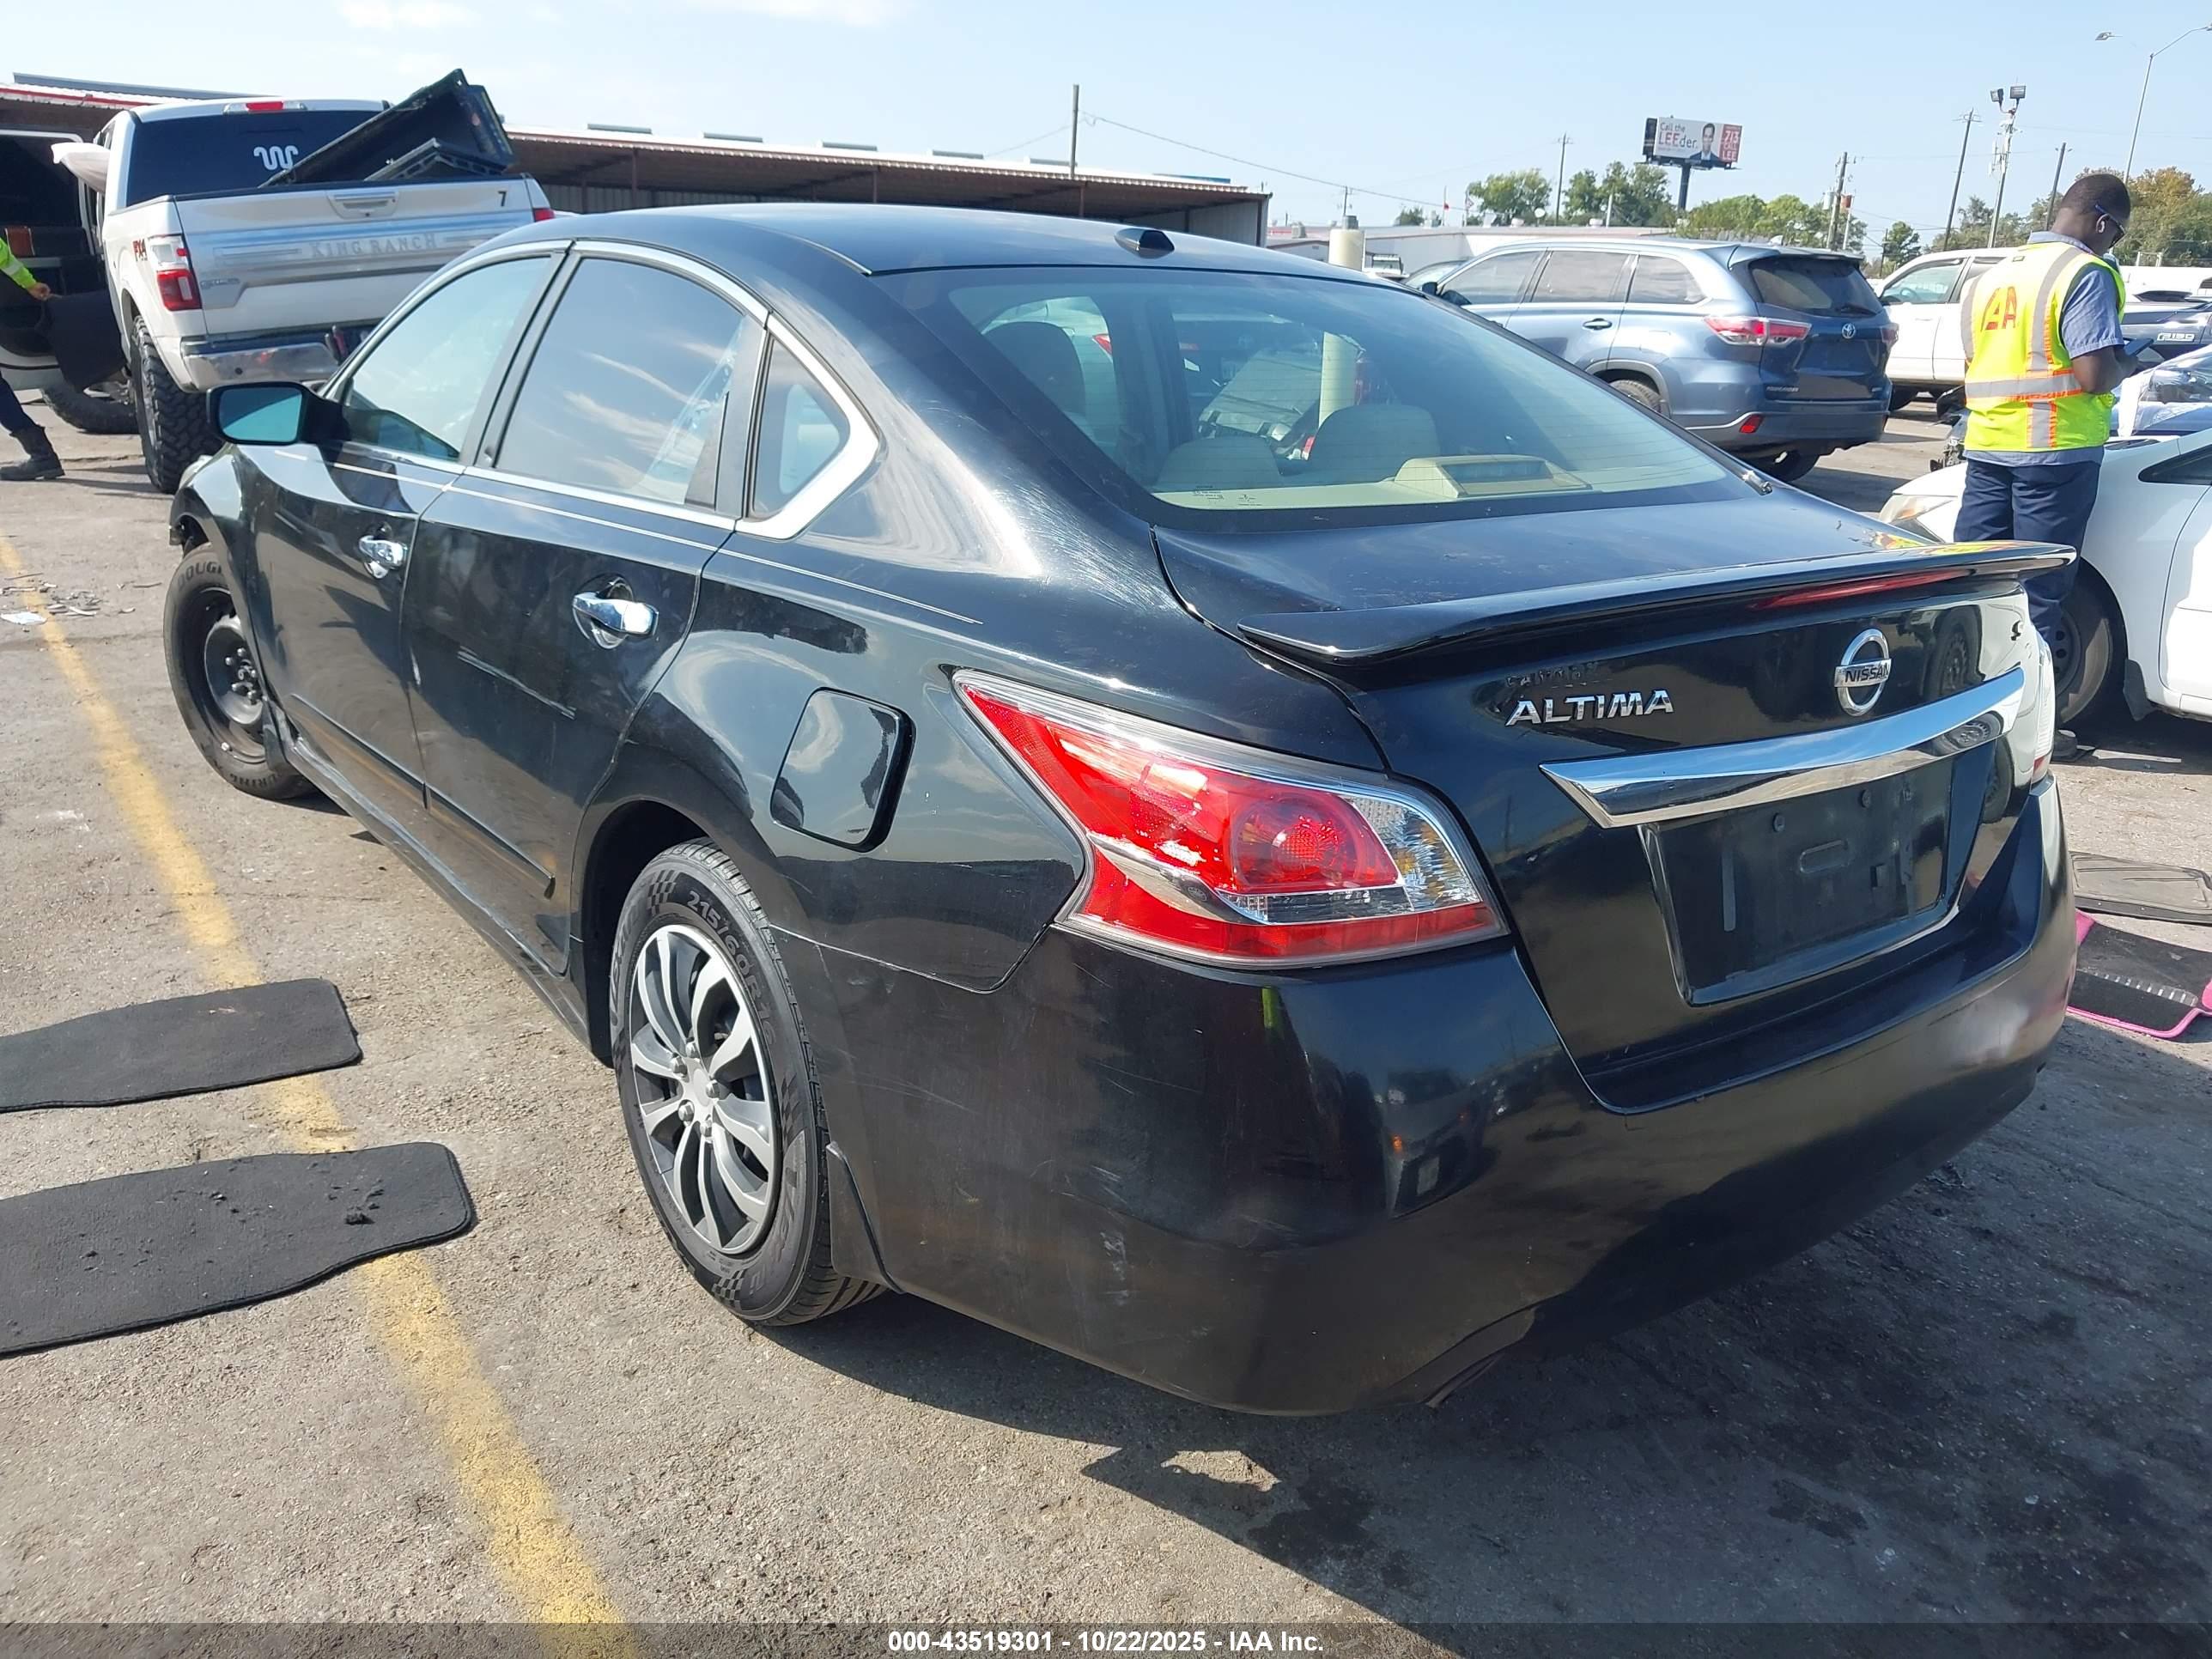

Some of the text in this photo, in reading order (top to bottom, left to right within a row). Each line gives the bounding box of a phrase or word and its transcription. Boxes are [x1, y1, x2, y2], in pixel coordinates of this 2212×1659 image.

[1659, 122, 1673, 131] Call
[498, 190, 507, 207] 7
[312, 232, 437, 258] KING RANCH
[1844, 661, 1889, 684] NISSAN
[1504, 689, 1674, 726] ALTIMA
